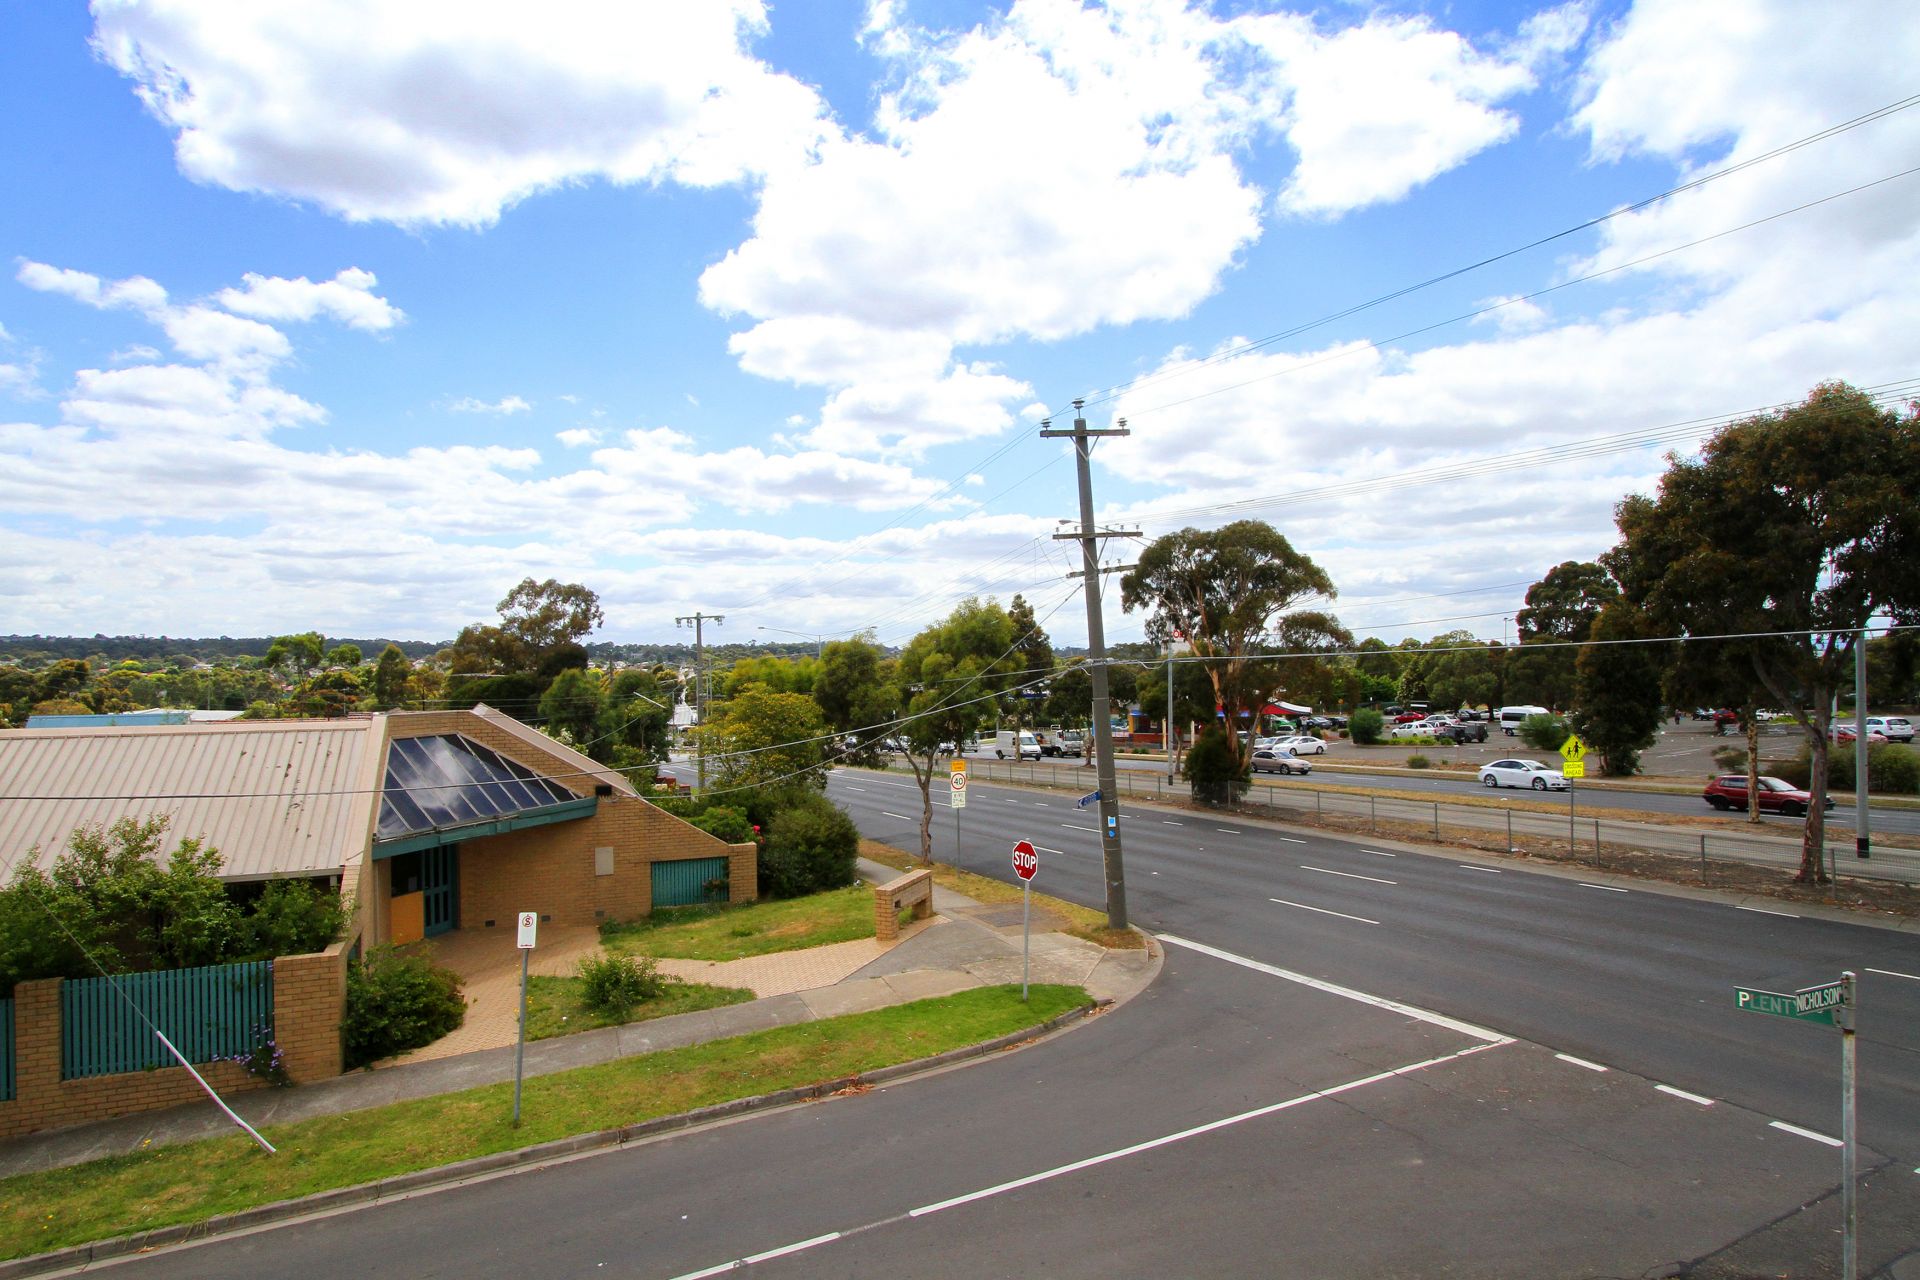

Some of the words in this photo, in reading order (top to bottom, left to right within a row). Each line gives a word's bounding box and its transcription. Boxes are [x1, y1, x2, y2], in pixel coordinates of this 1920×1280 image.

[954, 777, 963, 785] 40
[1014, 851, 1036, 870] STOP
[1796, 987, 1840, 1012] NICHOLSON
